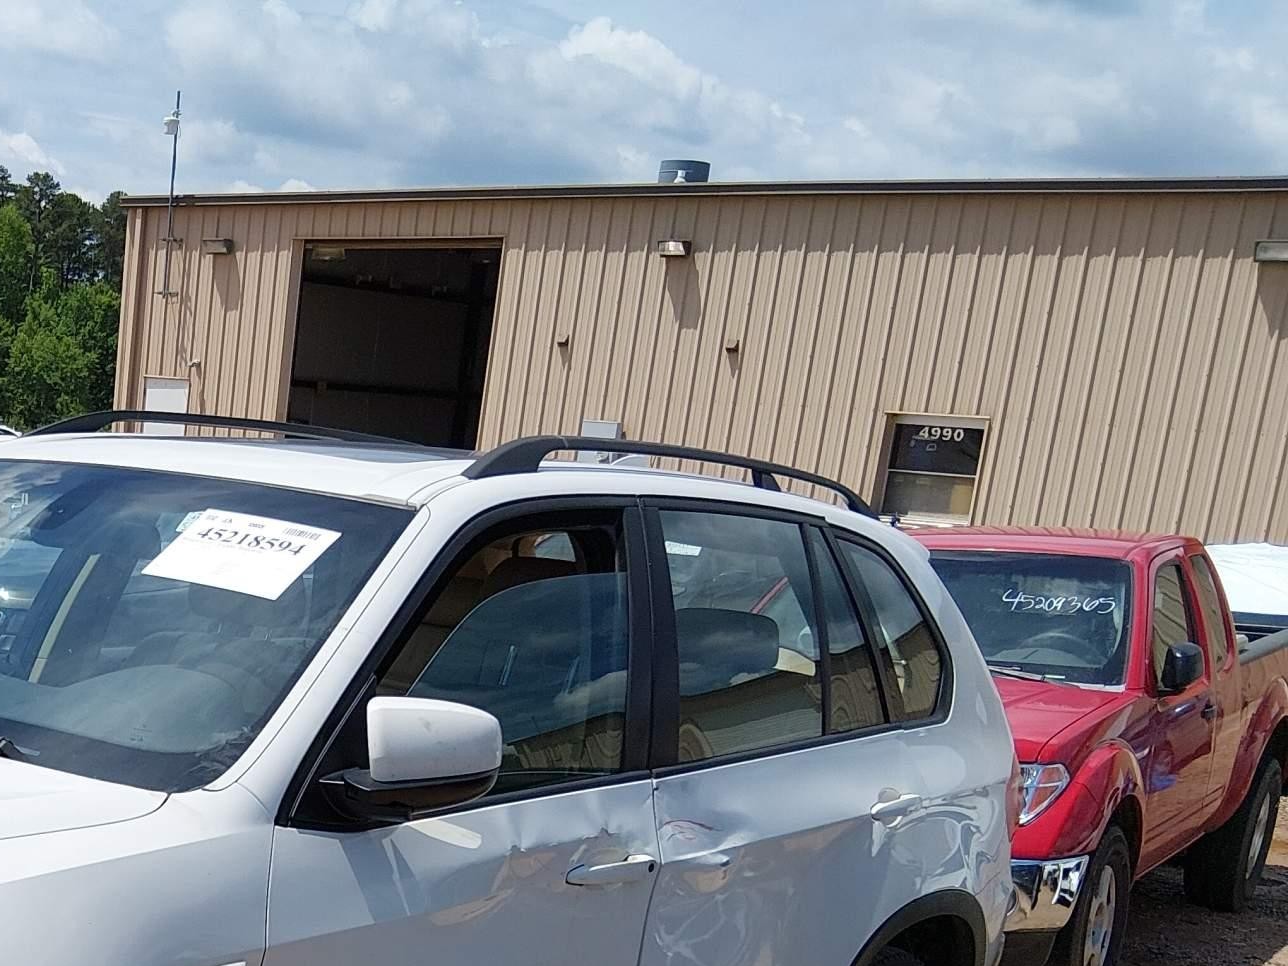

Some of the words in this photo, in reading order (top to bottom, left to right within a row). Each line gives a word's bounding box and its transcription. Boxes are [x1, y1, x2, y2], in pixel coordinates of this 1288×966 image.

[919, 426, 965, 442] 4990
[197, 527, 306, 556] 45218594
[1001, 588, 1117, 614] 45209365
